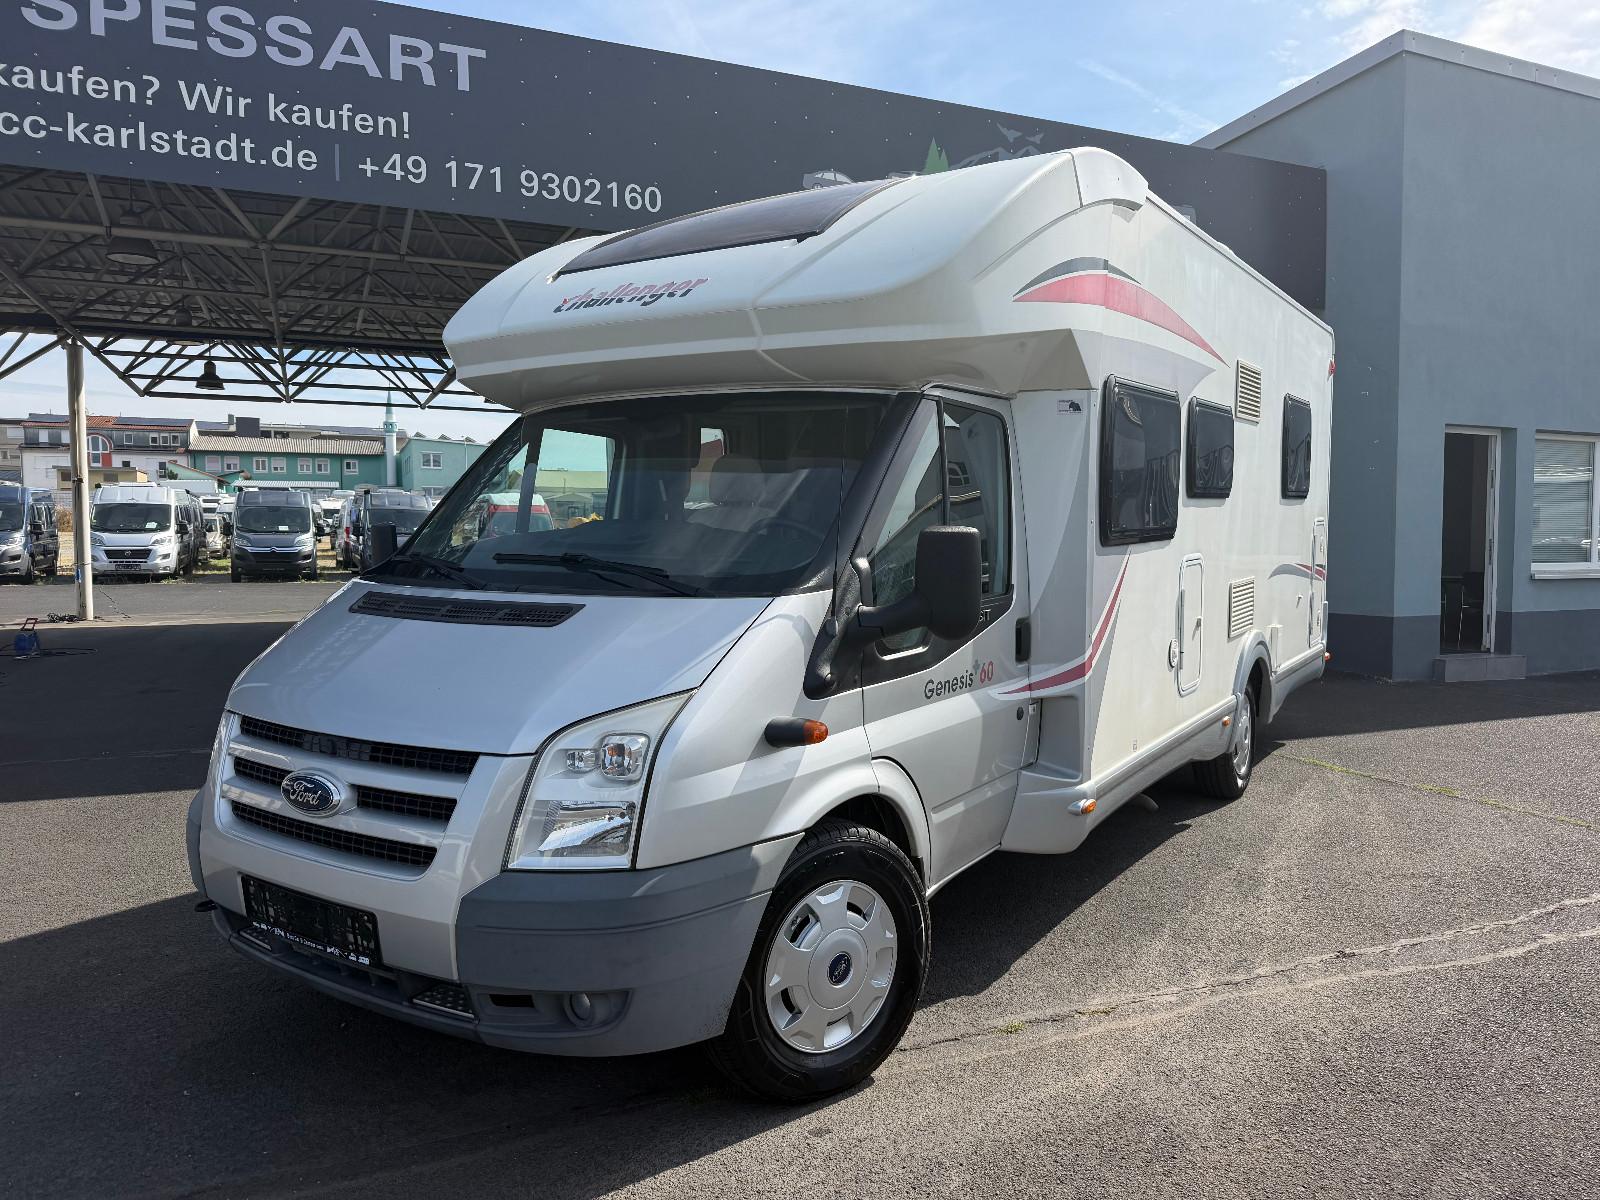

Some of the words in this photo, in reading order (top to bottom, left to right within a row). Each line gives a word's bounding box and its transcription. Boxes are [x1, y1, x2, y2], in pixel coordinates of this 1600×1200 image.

[178, 79, 252, 118] Wir
[268, 92, 410, 139] kaufen!
[0, 111, 318, 171] cc-karlstadt.de
[358, 153, 427, 184] +49
[445, 160, 502, 193] 171
[520, 169, 663, 213] 9302160
[289, 780, 322, 806] Ford
